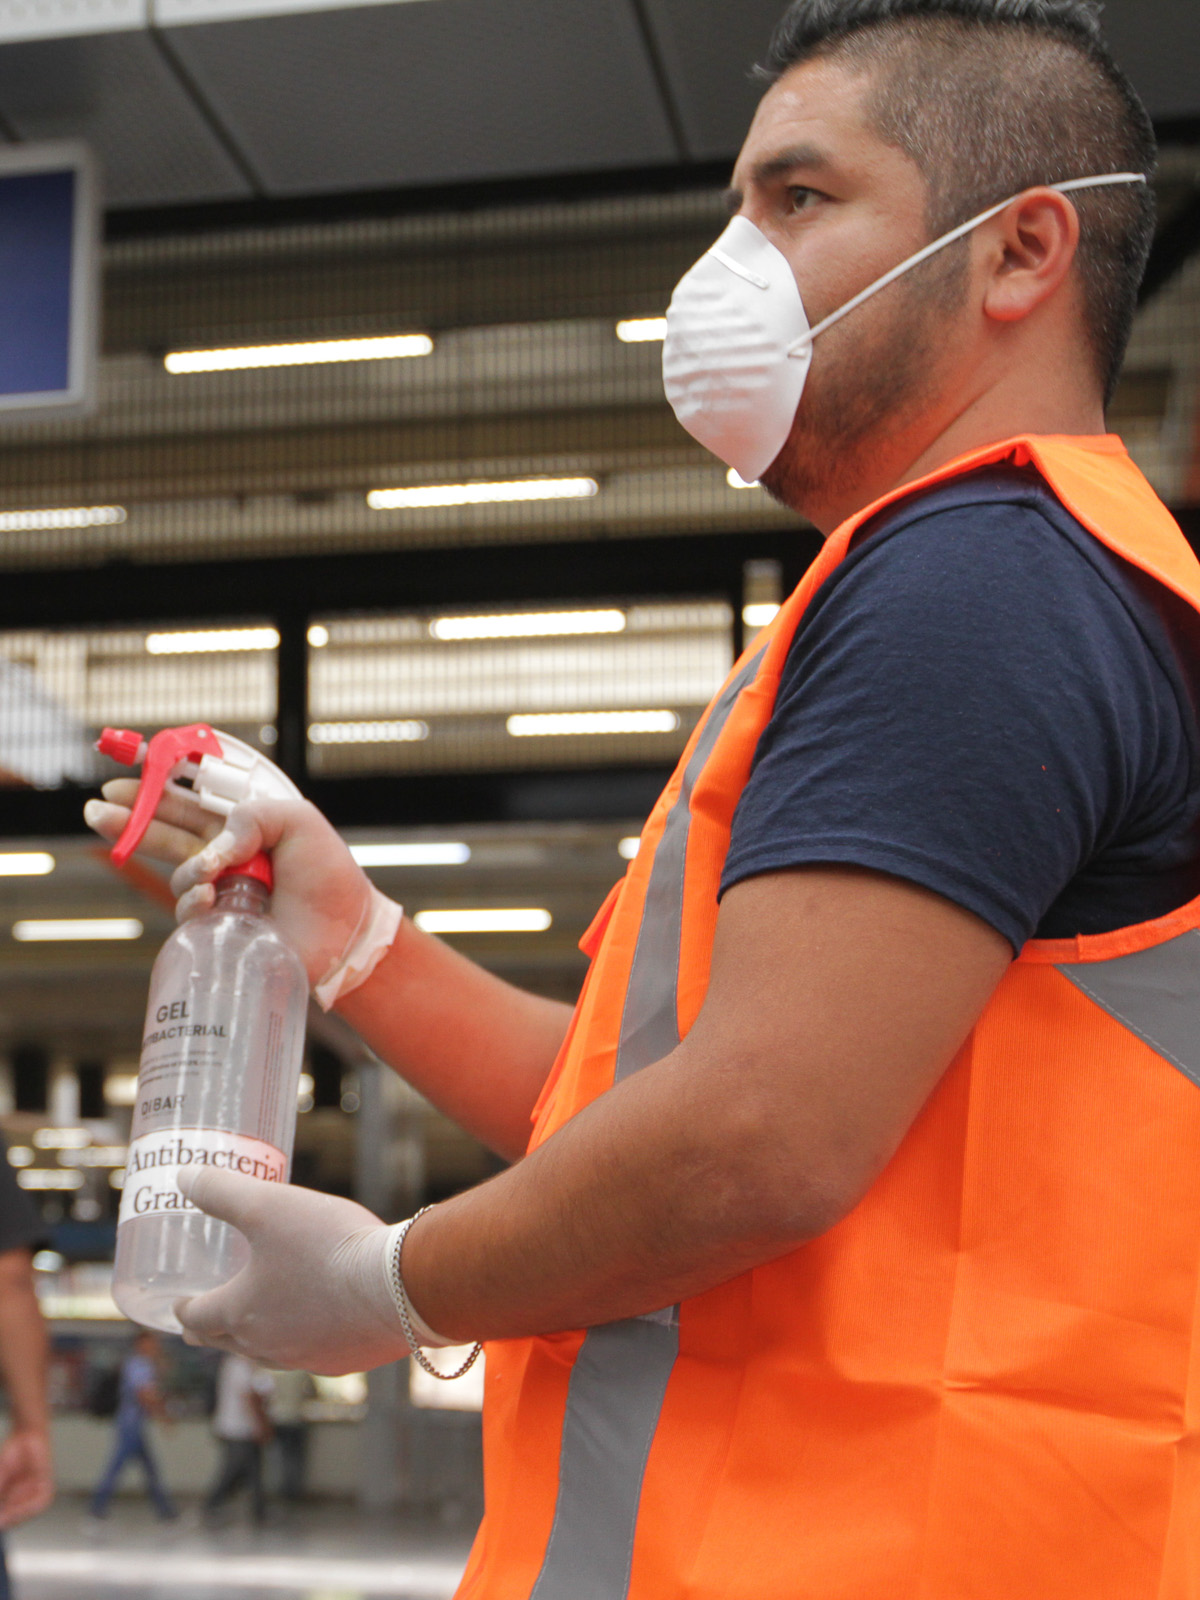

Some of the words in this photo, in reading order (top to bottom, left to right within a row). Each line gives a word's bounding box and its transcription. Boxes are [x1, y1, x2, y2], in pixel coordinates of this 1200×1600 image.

[156, 1000, 189, 1023] GEL
[143, 1024, 228, 1047] BACTERIAL
[126, 1139, 284, 1183] Antibacterial
[134, 1185, 196, 1214] Gra
